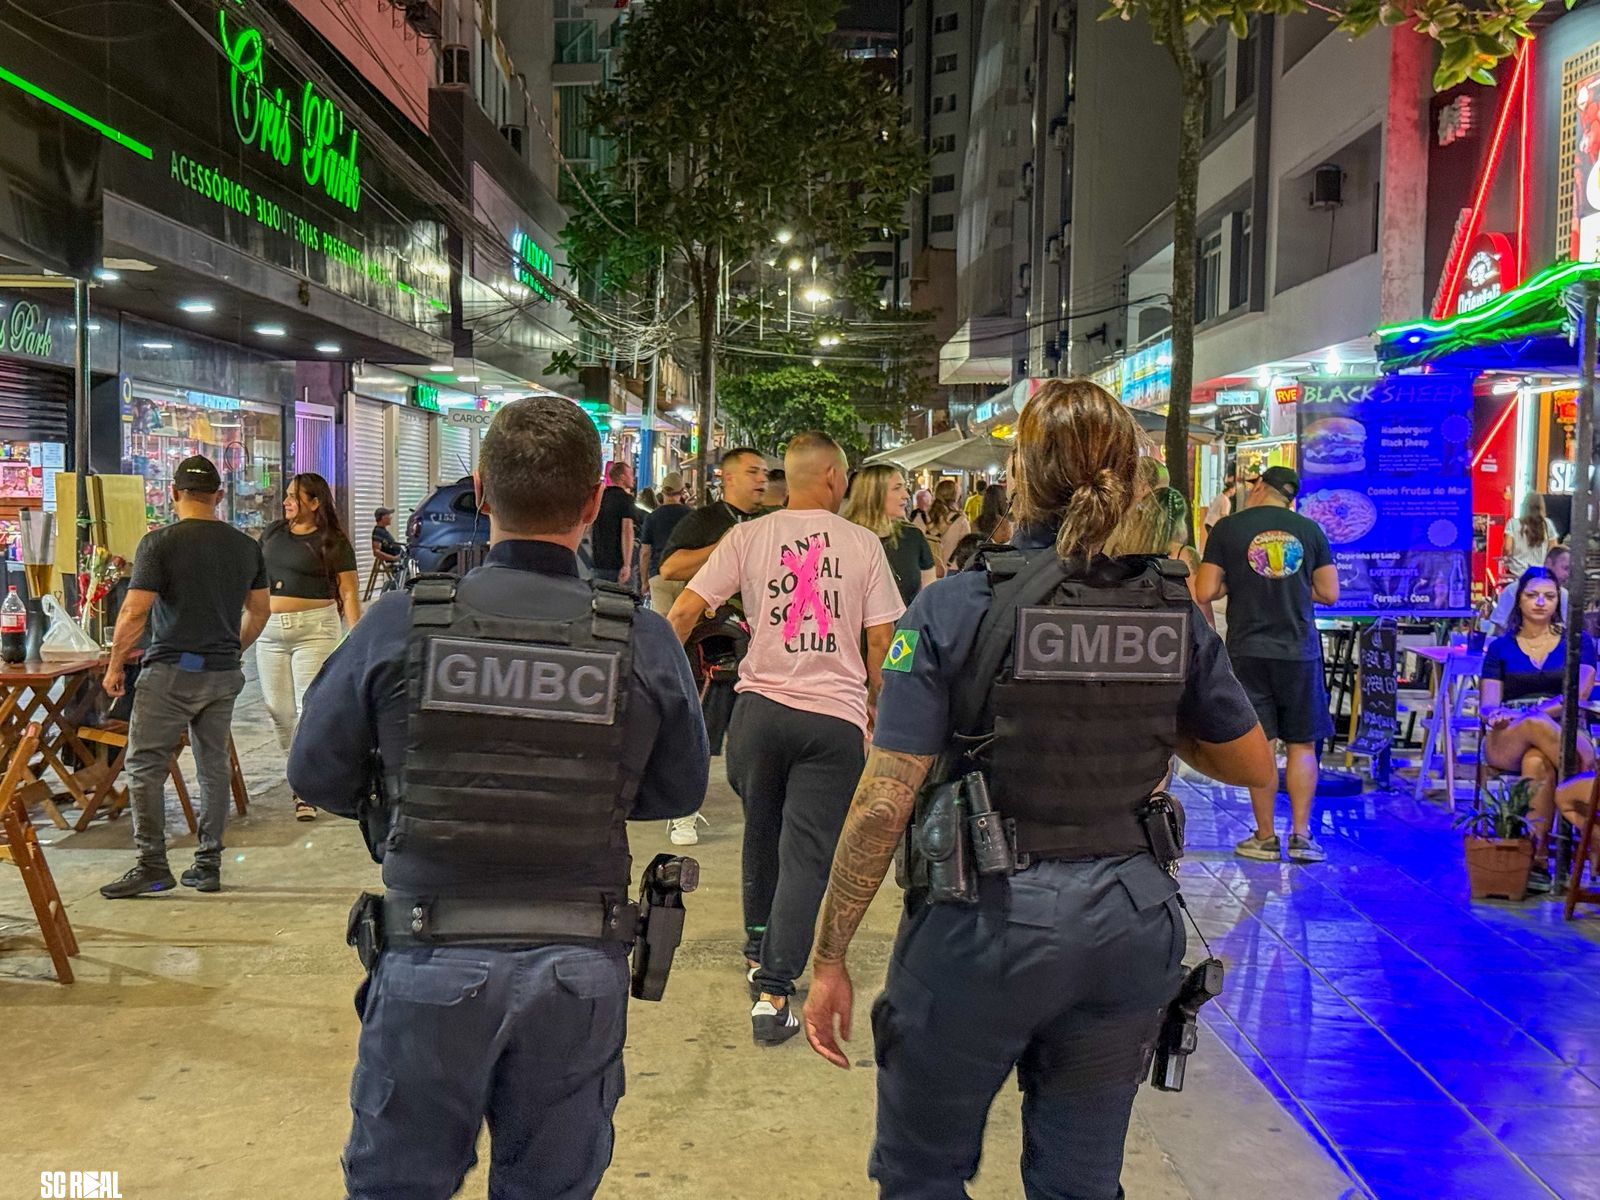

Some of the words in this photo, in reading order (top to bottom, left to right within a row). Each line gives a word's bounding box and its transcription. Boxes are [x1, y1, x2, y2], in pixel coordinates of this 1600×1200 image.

[170, 150, 251, 217] ACESSÓRIOS
[10, 300, 52, 357] Park
[1303, 385, 1376, 405] BLACK
[1380, 385, 1462, 404] SHEEP
[452, 412, 491, 425] CARIOC
[1381, 437, 1403, 447] Black
[1404, 437, 1430, 449] Sheep
[1367, 486, 1399, 496] Combo
[1447, 486, 1469, 496] Mar
[780, 531, 831, 566] ANTI
[767, 556, 843, 599] SOAL
[1409, 594, 1430, 604] Coca
[784, 632, 838, 654] CLUB
[1028, 622, 1179, 665] GMBC
[437, 653, 606, 706] GMBC
